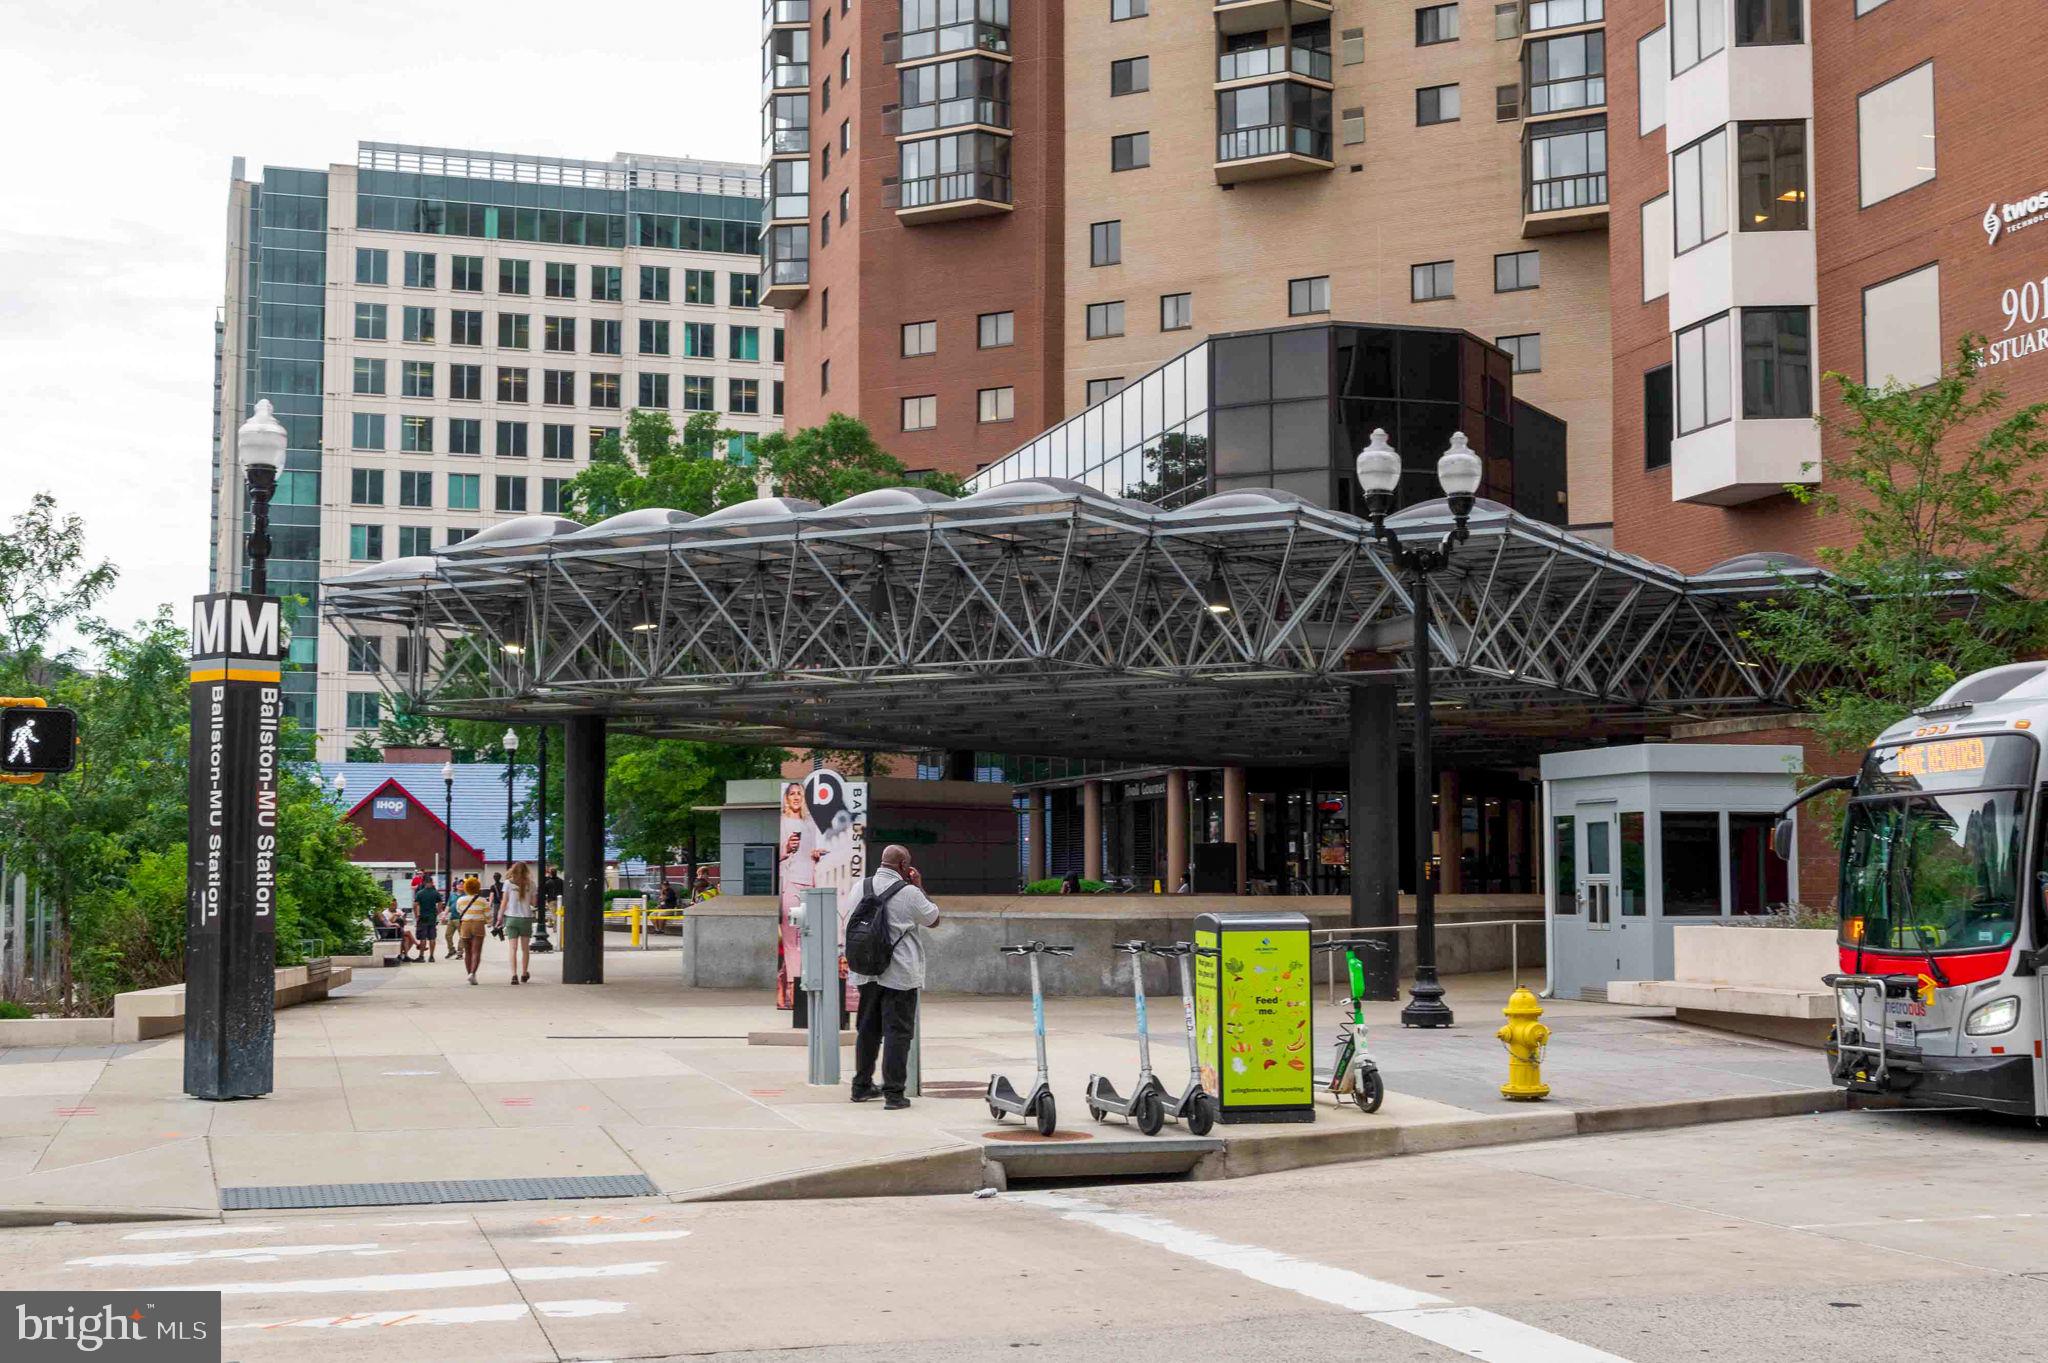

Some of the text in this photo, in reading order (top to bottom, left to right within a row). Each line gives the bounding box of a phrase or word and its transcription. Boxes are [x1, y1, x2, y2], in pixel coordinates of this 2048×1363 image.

[2001, 276, 2048, 332] 901
[193, 599, 226, 655] M
[231, 599, 279, 656] M
[208, 686, 224, 917] Ballston-MU Station
[256, 687, 279, 917] Ballston-MU Station
[852, 788, 863, 878] BALLSTON
[1255, 996, 1279, 1005] Feed
